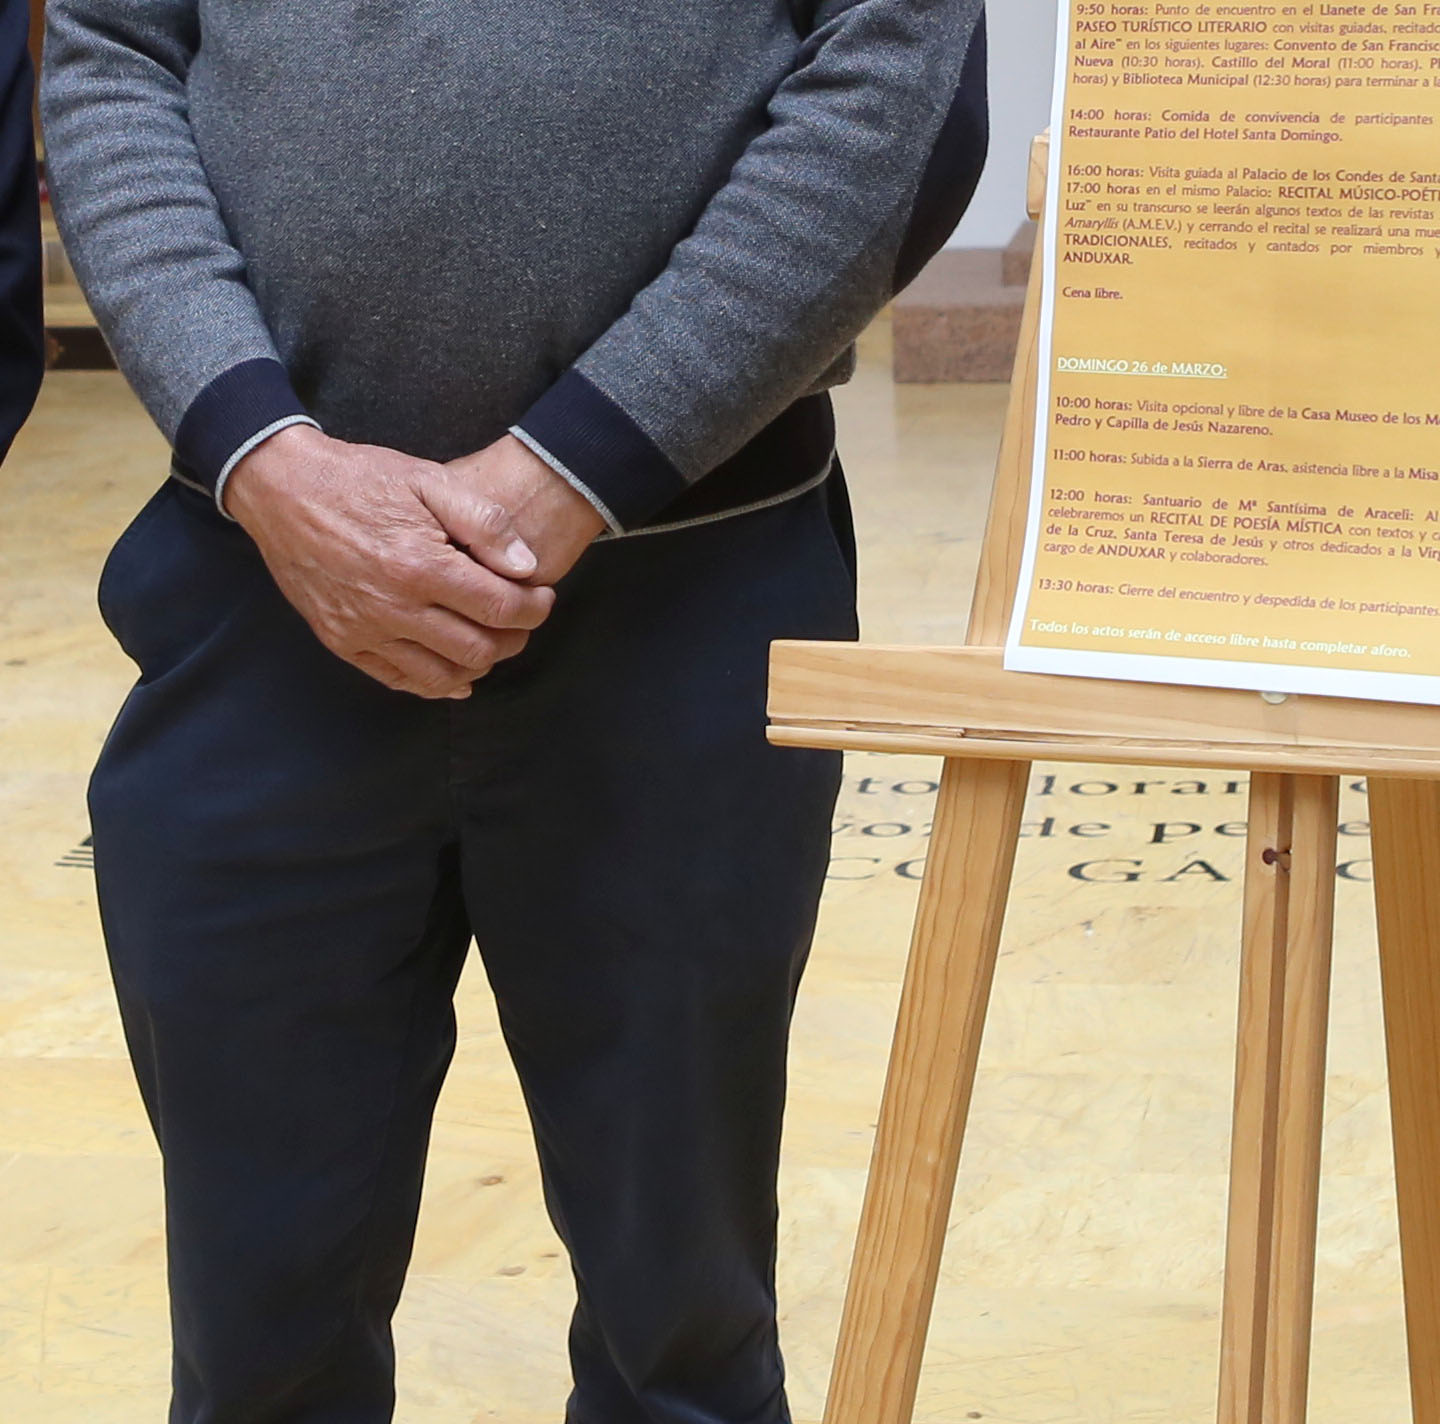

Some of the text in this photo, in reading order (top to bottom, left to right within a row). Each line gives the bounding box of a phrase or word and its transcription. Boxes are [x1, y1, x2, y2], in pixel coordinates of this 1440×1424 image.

[1111, 4, 1148, 16] horas:
[1155, 4, 1189, 16] Punto
[1195, 4, 1211, 16] de
[1216, 6, 1276, 16] encuentro
[1282, 7, 1297, 16] en
[1303, 4, 1313, 16] el
[1372, 4, 1388, 16] de
[1394, 4, 1416, 16] San
[1076, 21, 1117, 33] PASEO
[1122, 19, 1192, 33] TURÍSTICO
[1197, 21, 1267, 33] LITERARIO
[1272, 24, 1294, 33] con
[1299, 22, 1335, 34] visitas
[1068, 126, 1342, 144] Restaurante Patio del Hotel Santa Domingo.
[1062, 286, 1123, 299] Cena libre.
[1057, 358, 1228, 377] DOMINGO 26 de MARZO:
[1030, 619, 1411, 658] Todos los actos serán de acceso libre hasta completar aforo.
